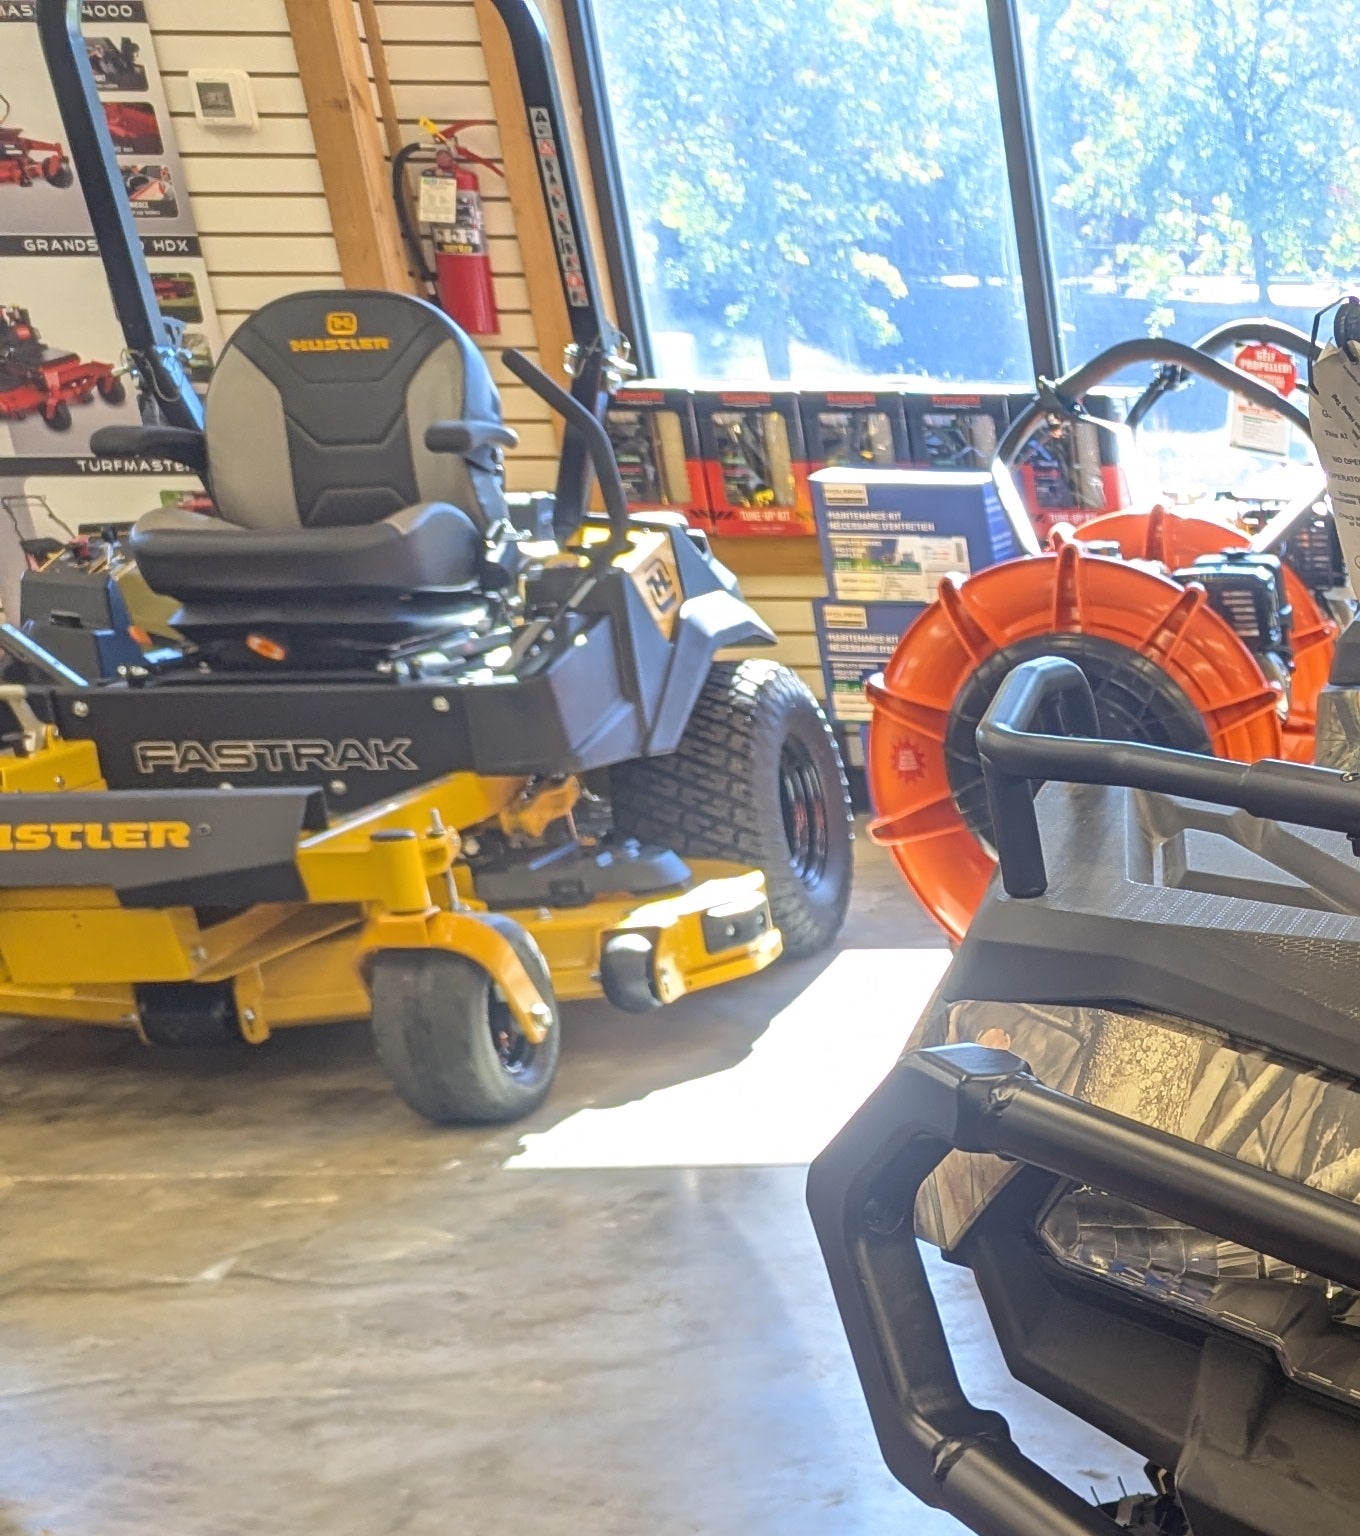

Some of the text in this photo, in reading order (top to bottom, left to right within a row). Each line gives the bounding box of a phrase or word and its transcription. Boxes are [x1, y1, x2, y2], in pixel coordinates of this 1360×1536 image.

[82, 5, 133, 18] 4000
[153, 239, 189, 252] HDX
[289, 338, 390, 353] HUSTLER
[77, 460, 194, 473] TURFMASTE
[133, 737, 420, 774] FASTRAK
